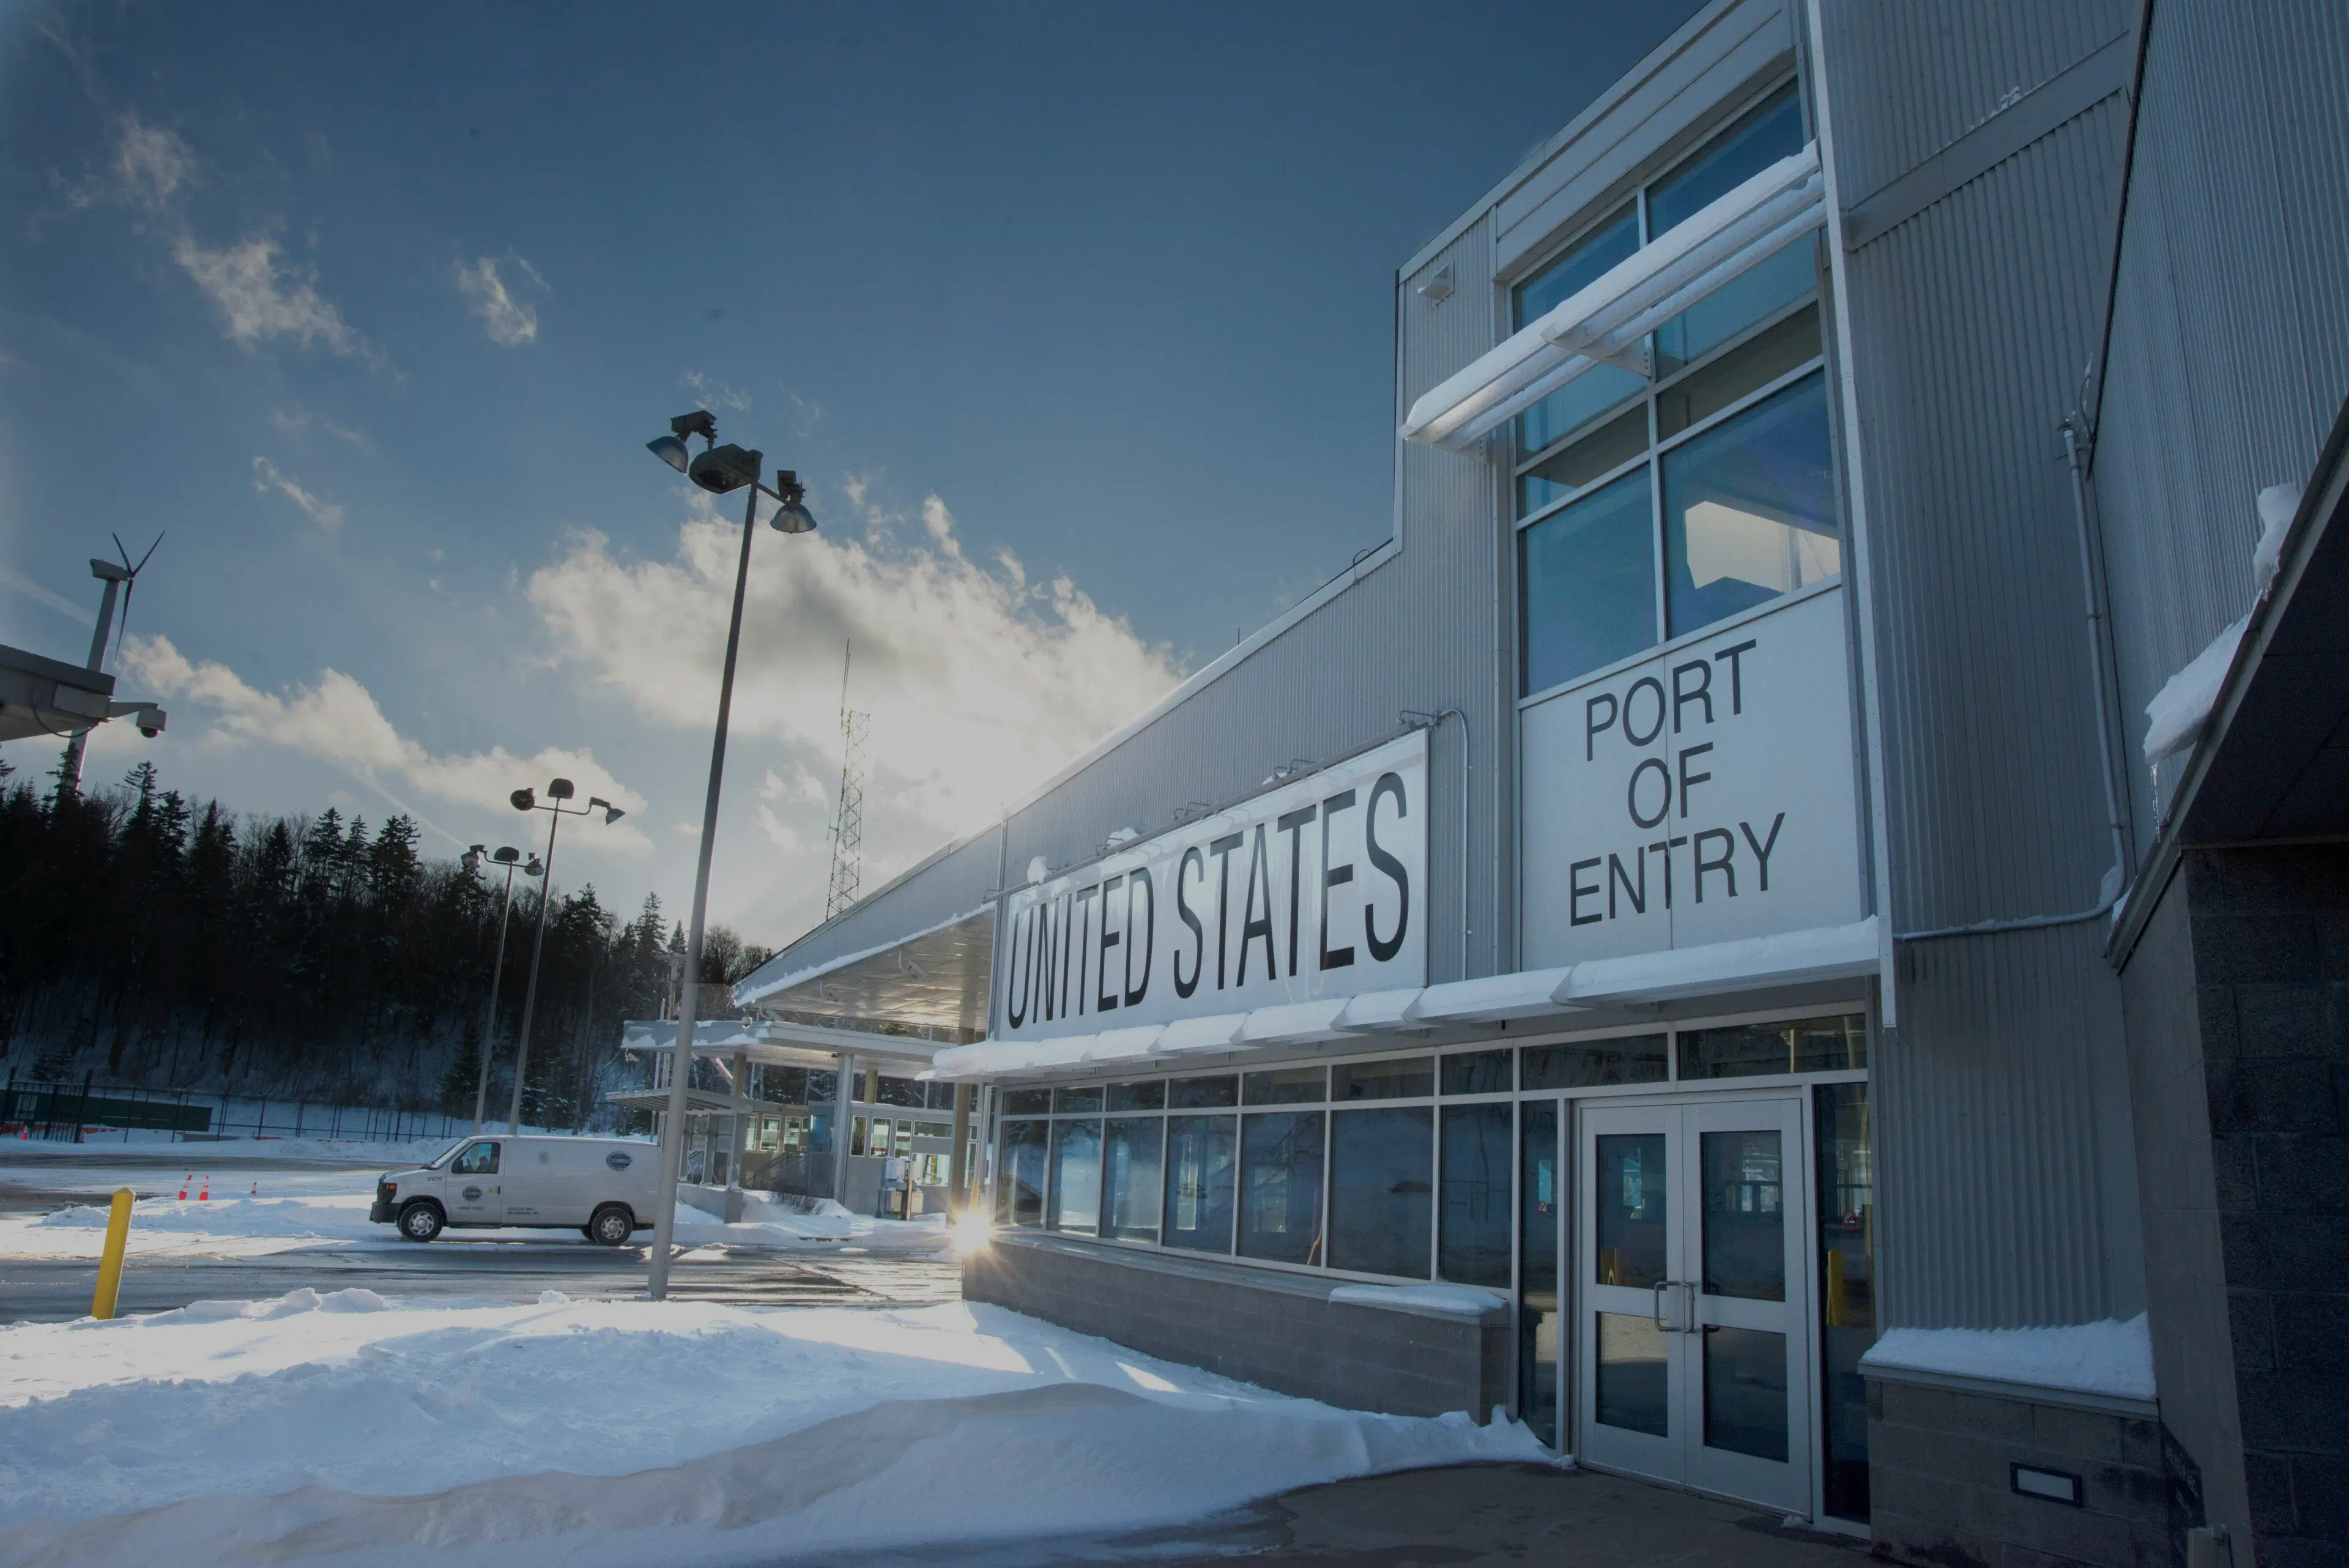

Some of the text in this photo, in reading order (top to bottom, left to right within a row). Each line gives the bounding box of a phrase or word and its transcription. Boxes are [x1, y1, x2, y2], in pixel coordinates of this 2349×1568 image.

[1586, 639, 1756, 762] PORT
[1628, 741, 1713, 829] OF
[1008, 772, 1408, 1029] UNITED STATES
[1570, 812, 1786, 926] ENTRY
